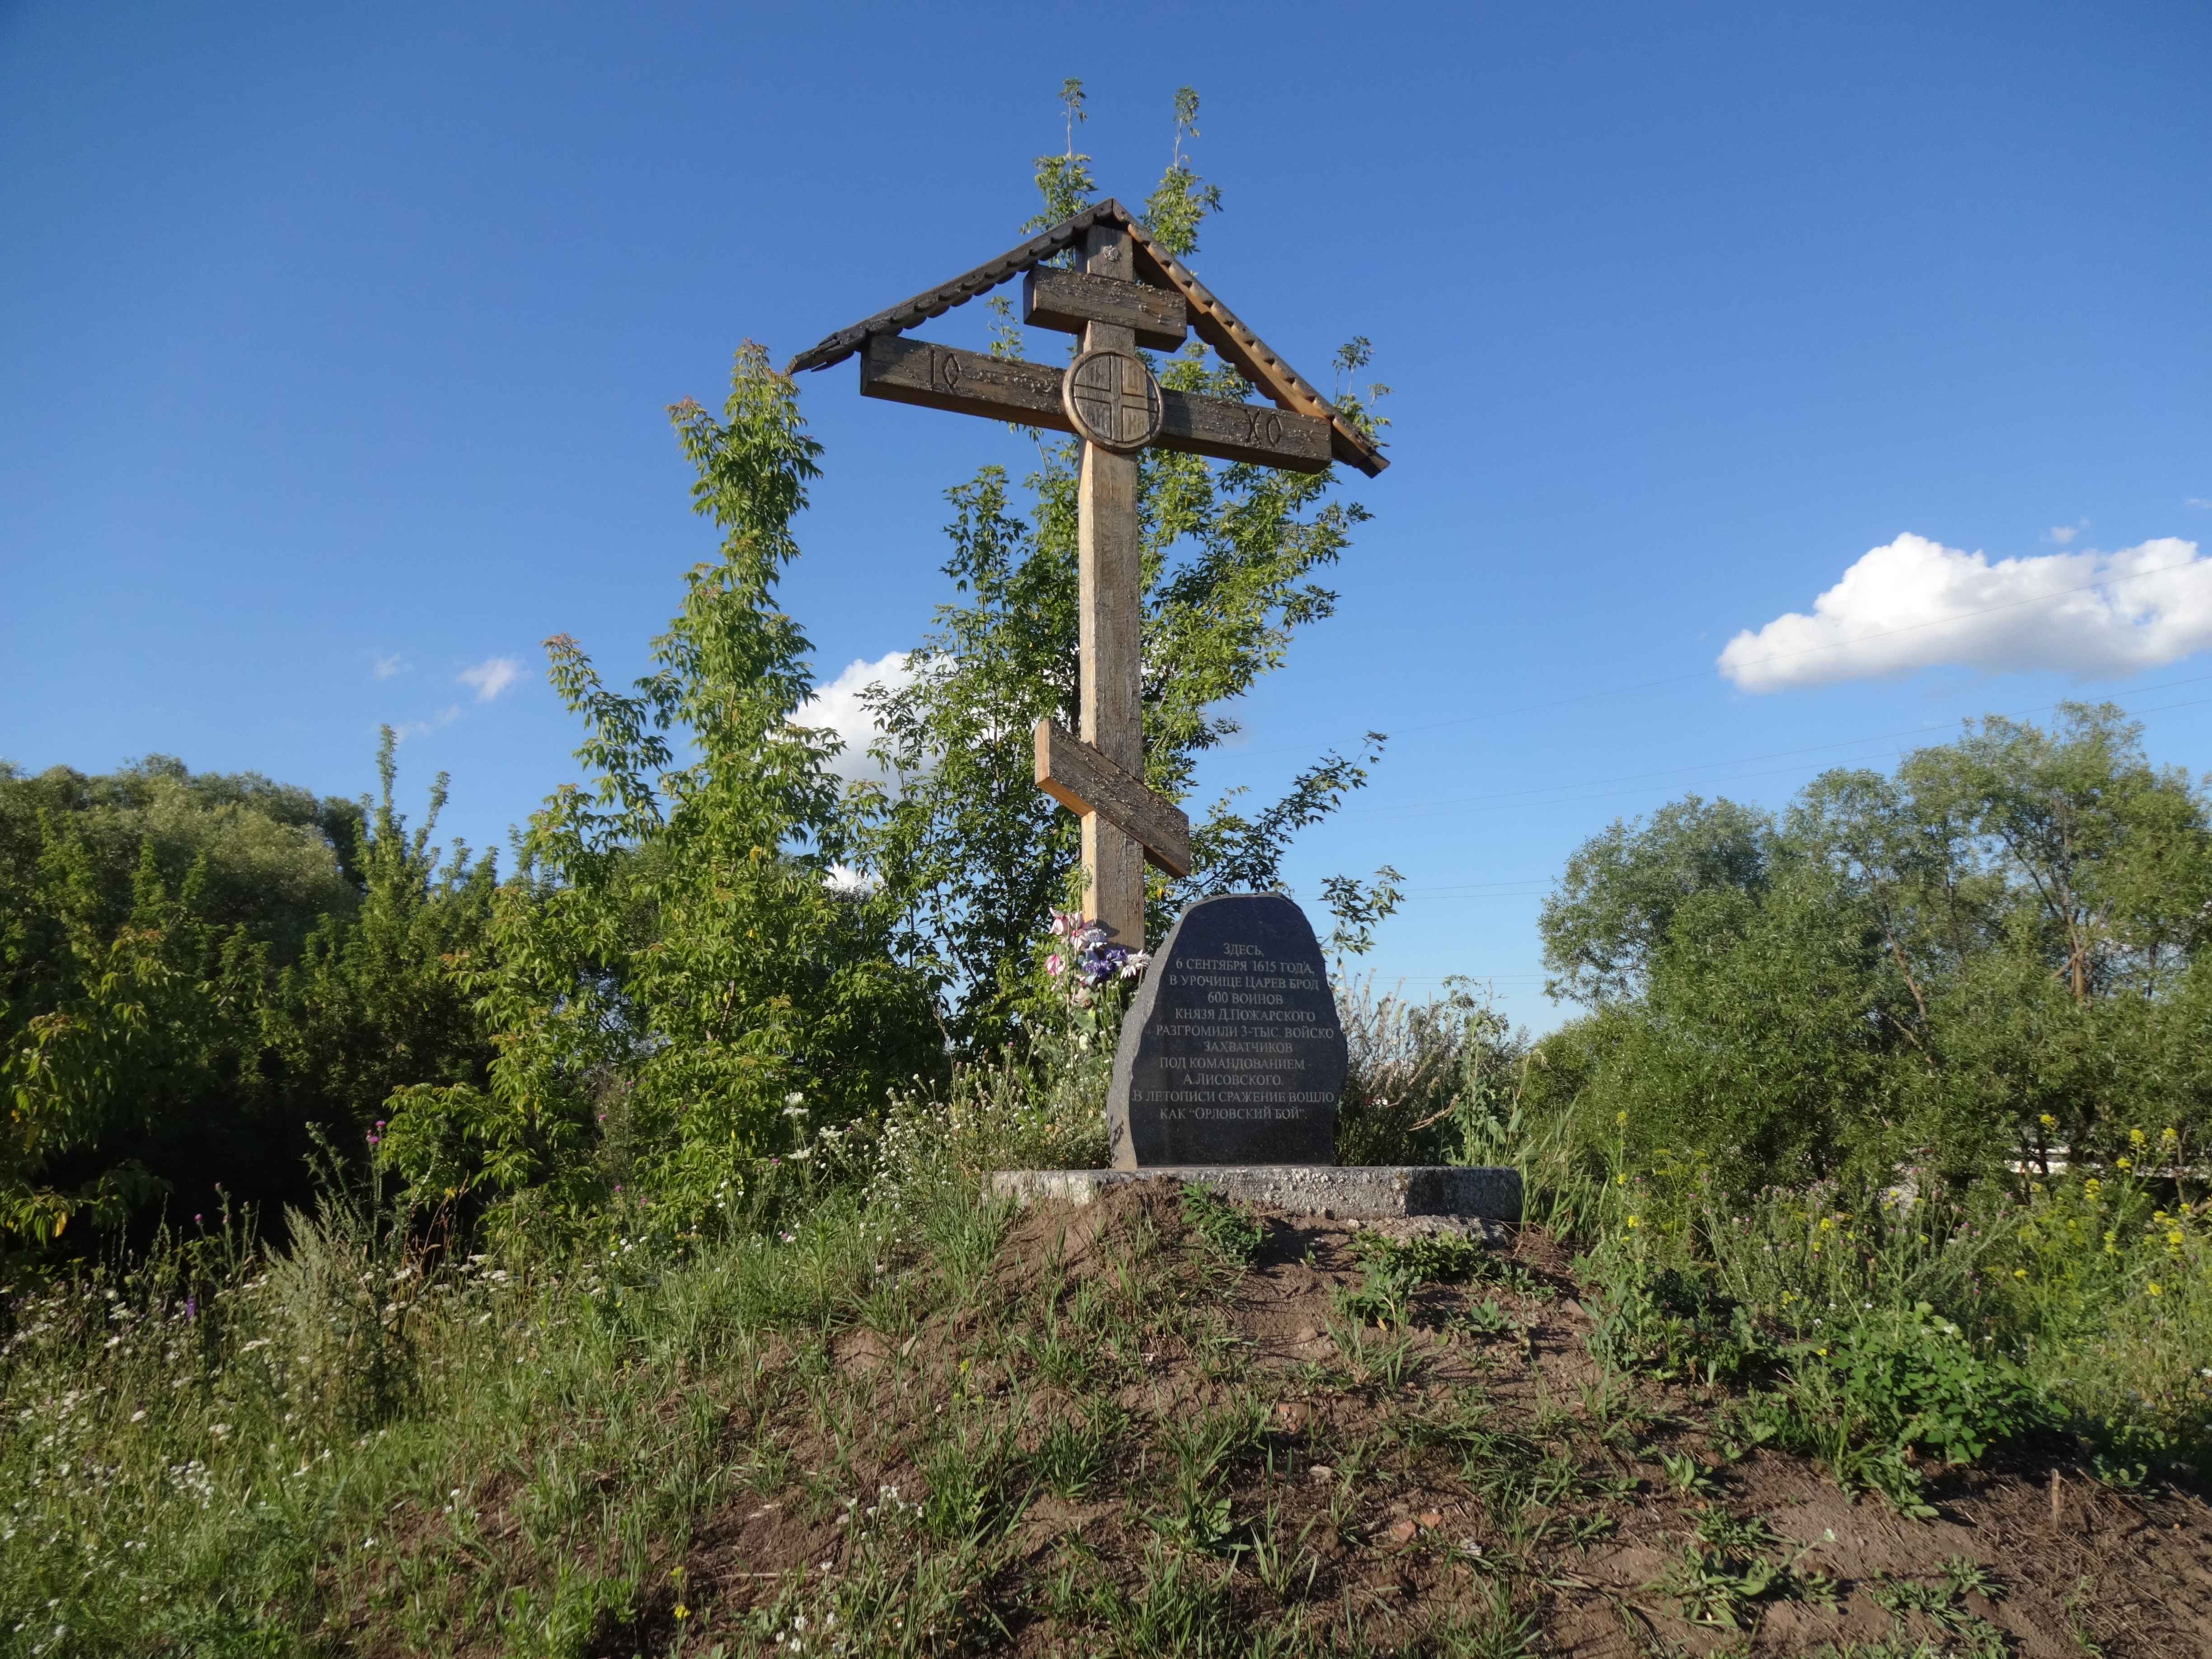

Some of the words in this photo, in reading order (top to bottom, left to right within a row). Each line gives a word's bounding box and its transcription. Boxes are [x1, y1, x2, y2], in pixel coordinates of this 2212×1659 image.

[1223, 943, 1264, 956] ЗДЕСЬ,
[1176, 958, 1183, 969] 6
[1186, 959, 1247, 971] СЕНТЯБРЯ
[1253, 961, 1275, 972] 1615
[1280, 962, 1314, 975] ГОДА,
[1170, 975, 1177, 985] В
[1181, 975, 1242, 989] УРОЧИЩЕ
[1245, 977, 1286, 989] ЦАРЕВ
[1289, 979, 1319, 991] БРОД
[1208, 992, 1228, 1003] 600
[1232, 993, 1283, 1005] ВОИНОВ
[1175, 1008, 1214, 1019] КНЯЗЯ
[1218, 1008, 1315, 1022] Д.ПОЖАРСКОГО
[1156, 1025, 1237, 1036] РАЗГРОМИЛИ
[1242, 1026, 1281, 1037] 3-ТЫС.
[1285, 1026, 1334, 1038] ВОЙСКО
[1204, 1041, 1293, 1053] ЗАХВАТЧИКОВ
[1160, 1057, 1186, 1069] ПОД
[1190, 1058, 1305, 1070] КОМАНДОВАНИЕМ
[1183, 1073, 1284, 1085] А.ЛИСОВСКОГО.
[1133, 1090, 1142, 1101] В
[1146, 1091, 1215, 1102] ЛЕТОПИСИ
[1218, 1092, 1285, 1102] СРАЖЕНИЕ
[1289, 1092, 1334, 1102] ВОШЛО
[1160, 1108, 1186, 1119] КАК
